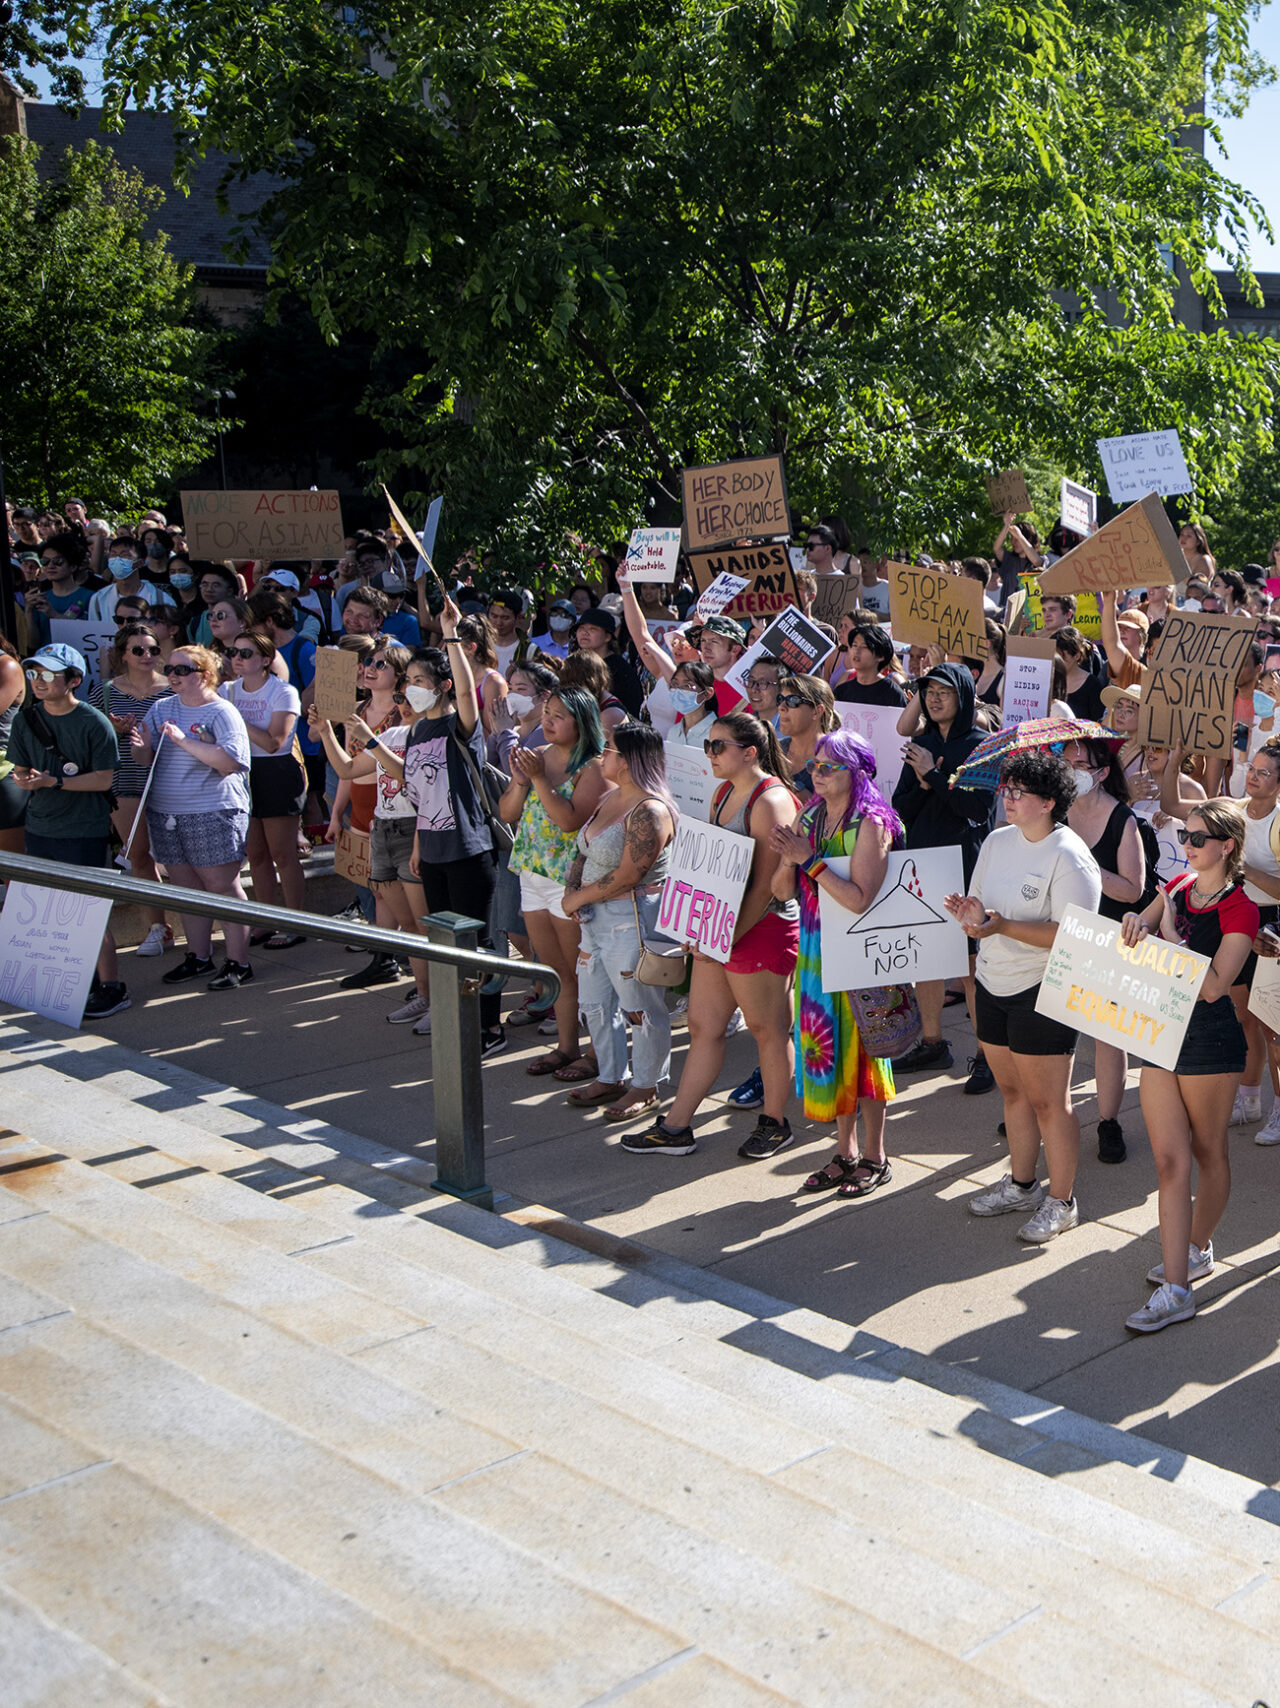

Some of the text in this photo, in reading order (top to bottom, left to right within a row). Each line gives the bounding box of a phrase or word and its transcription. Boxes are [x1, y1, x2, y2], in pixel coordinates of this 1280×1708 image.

[1109, 442, 1174, 464] LOVE US
[692, 470, 775, 502] HER BODY
[186, 493, 339, 516] MORE ACTIONS
[696, 498, 785, 535] HER CHOICE
[194, 520, 344, 551] FOR ASIANS
[1125, 517, 1150, 544] IS
[647, 547, 663, 556] Held
[707, 548, 785, 579] HANDS
[1072, 546, 1147, 587] REBEL
[753, 571, 786, 594] MY
[897, 571, 948, 600] STOP
[784, 612, 800, 627] THE
[909, 598, 969, 628] ASIAN
[777, 619, 818, 659] BILLIONAIRES
[781, 637, 800, 657] HAVE
[797, 652, 814, 669] TWO
[937, 627, 989, 659] HATE
[1156, 618, 1254, 670] PROTECT
[1019, 665, 1037, 673] STOP
[1014, 681, 1041, 691] HIDING
[1145, 667, 1229, 711] ASIAN
[1006, 714, 1023, 722] STOP
[1013, 698, 1039, 707] RACISM
[1147, 706, 1226, 750] LIVES
[672, 826, 750, 884] MIND UR OWN
[17, 883, 101, 927] STOP
[660, 876, 735, 954] UTERUS
[8, 934, 71, 954] ASIAN WOMEN
[1064, 915, 1207, 985] Men of QUALITY
[874, 949, 918, 976] NO!
[0, 959, 81, 1012] HATE
[1081, 959, 1161, 1007] dont FEAR
